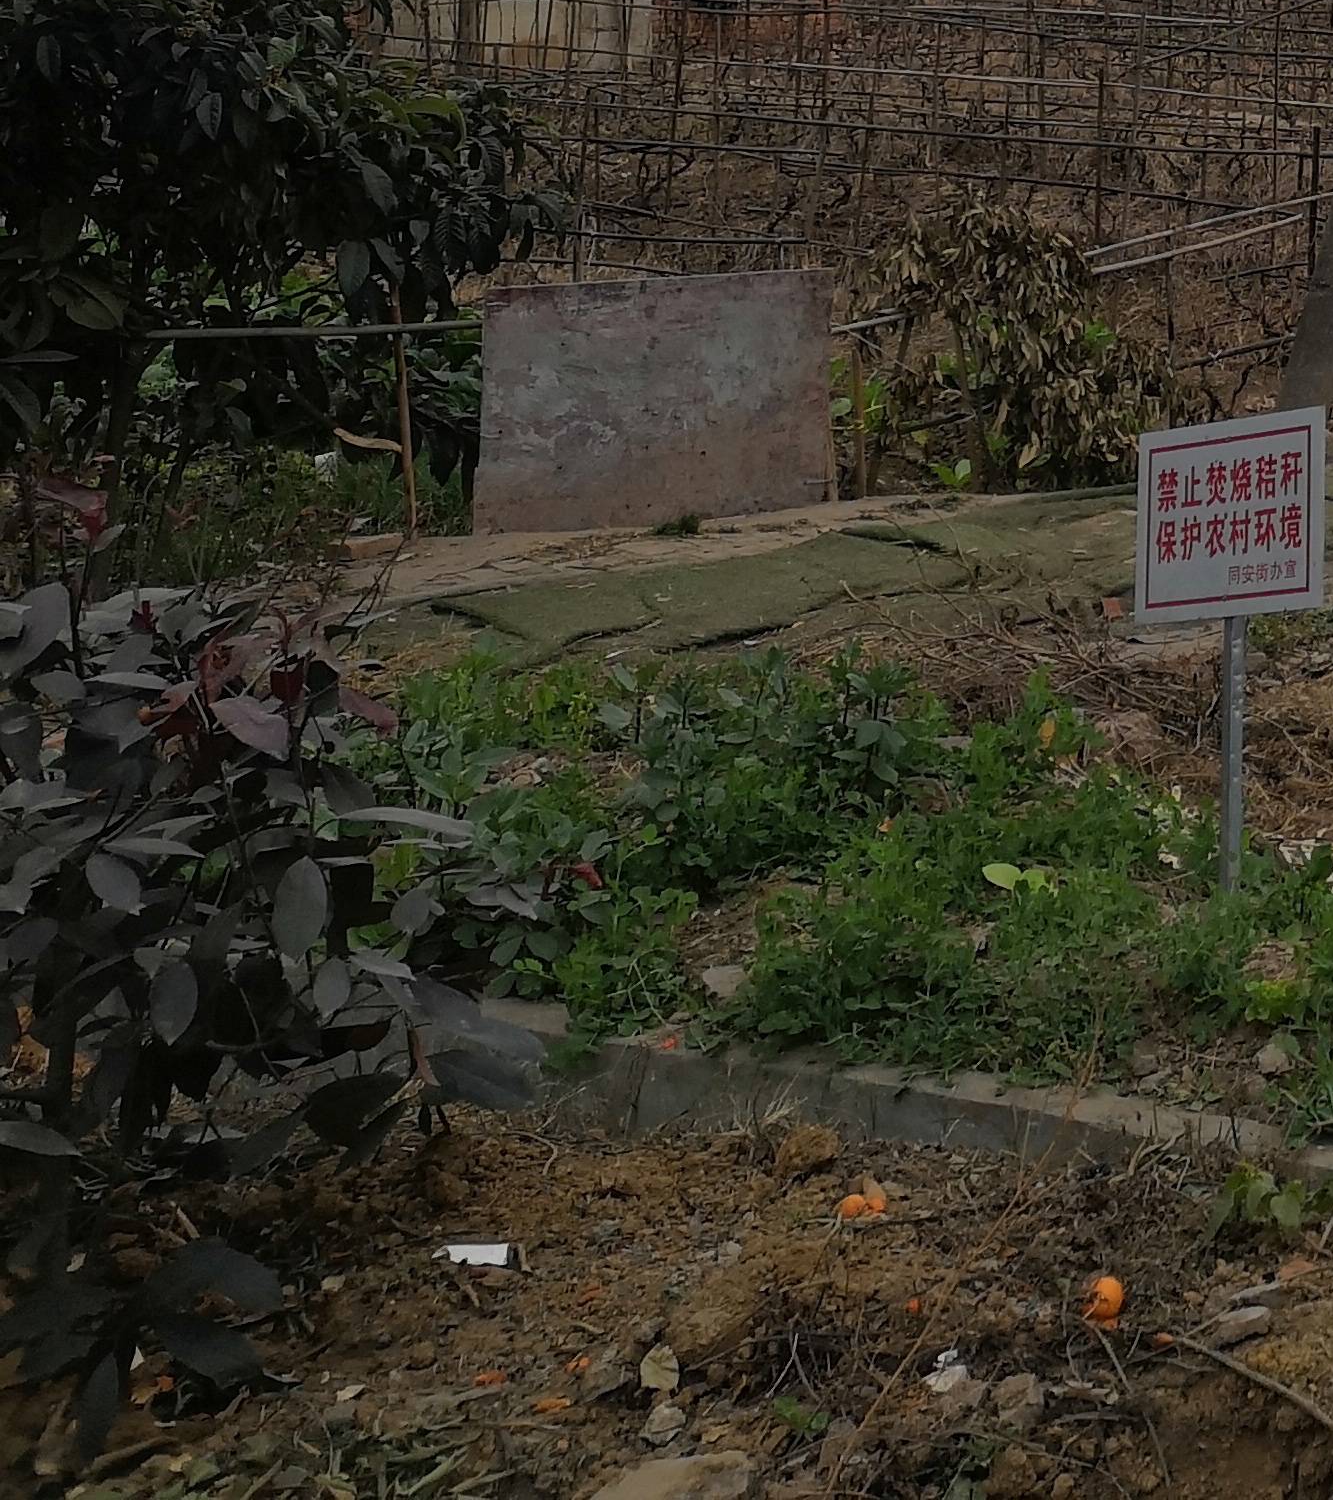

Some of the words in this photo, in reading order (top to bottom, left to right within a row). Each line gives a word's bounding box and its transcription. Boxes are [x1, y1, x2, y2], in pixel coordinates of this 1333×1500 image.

[1157, 451, 1303, 513] 禁止焚烧秸秆
[1155, 503, 1303, 564] 保护农村环境
